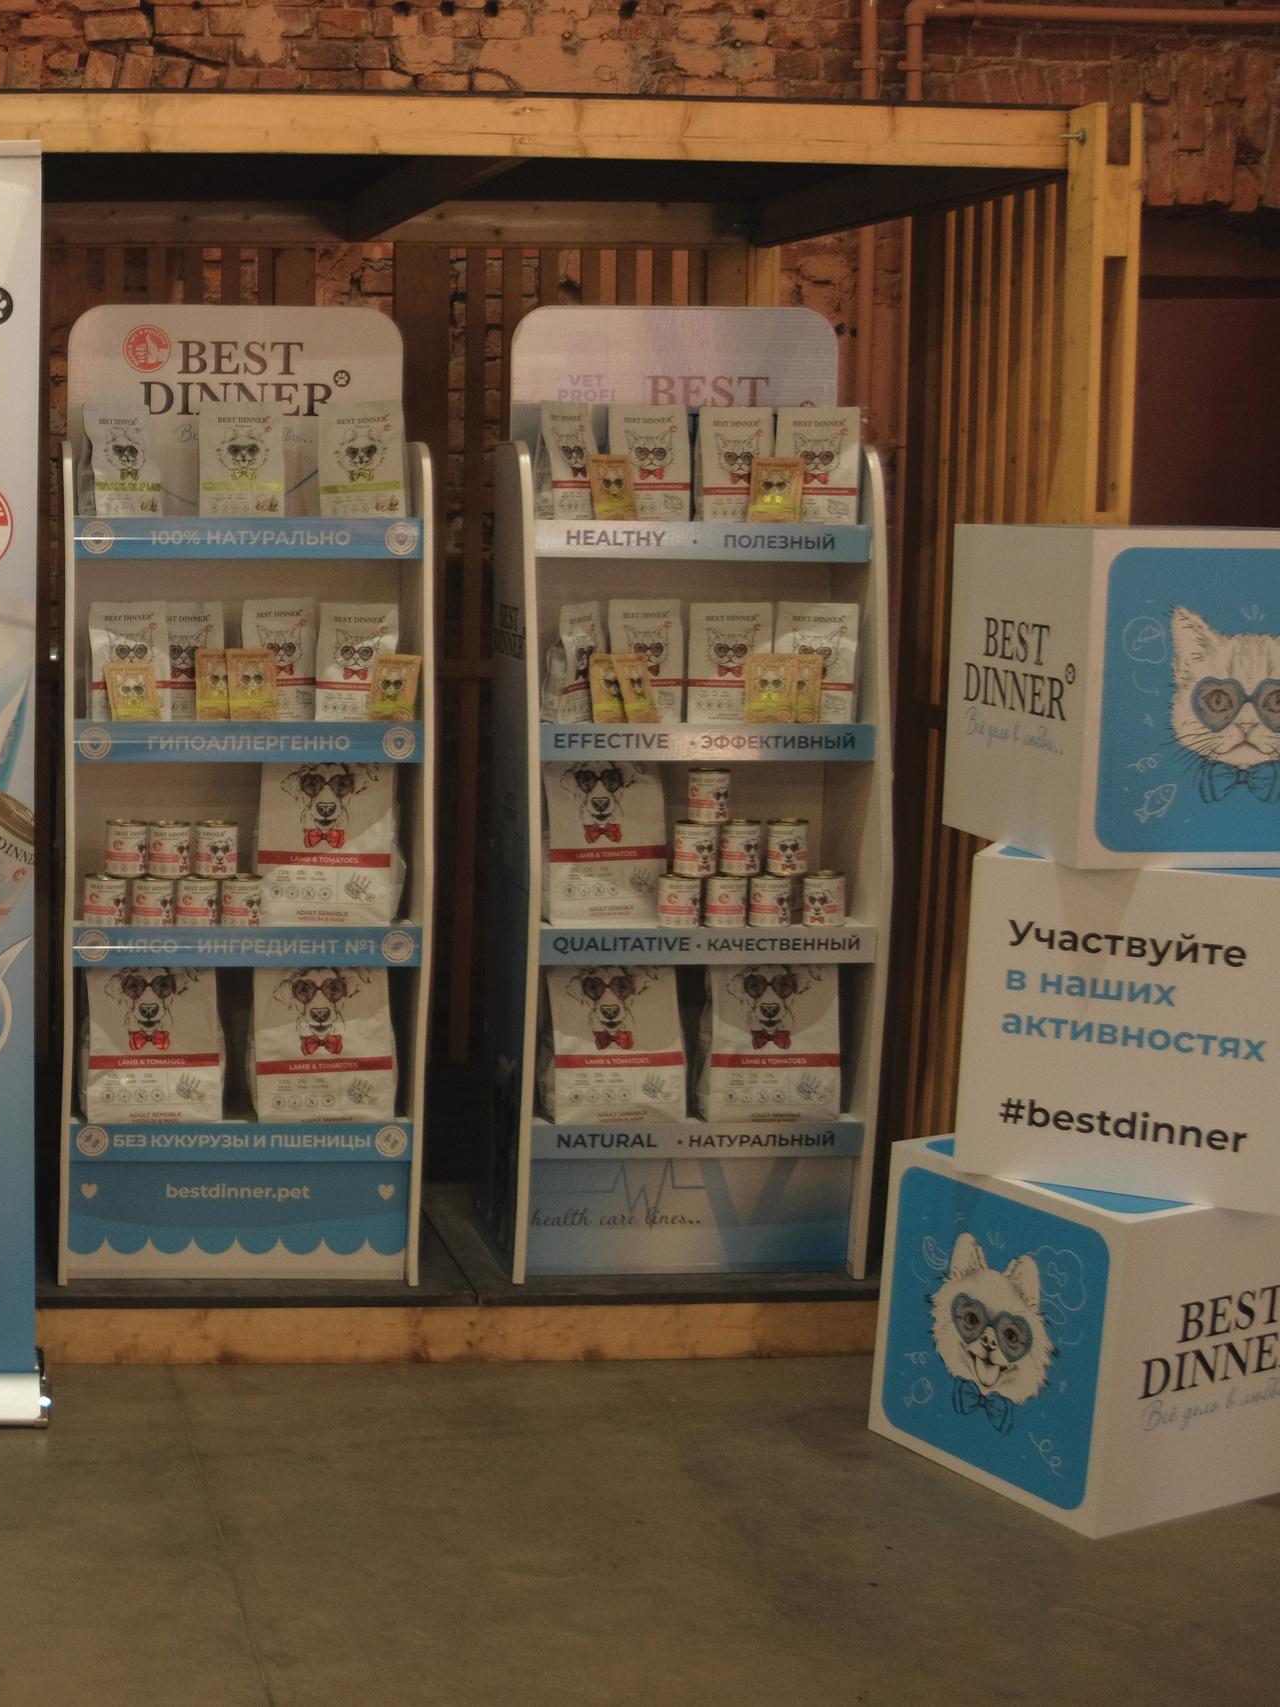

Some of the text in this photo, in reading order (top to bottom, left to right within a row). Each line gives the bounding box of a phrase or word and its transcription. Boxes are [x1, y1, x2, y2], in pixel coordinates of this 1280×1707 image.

[177, 341, 304, 376] BEST
[569, 375, 605, 387] VET
[557, 389, 615, 402] PROFI
[647, 375, 769, 407] BEST
[217, 416, 268, 424] BEST DINNER
[357, 416, 387, 424] DINNER
[149, 530, 351, 546] 100% НАТУРАЛЬНО
[565, 530, 666, 547] HEALTHY
[724, 532, 836, 550] ПОЛЕЗНЫЙ
[124, 613, 152, 621] DINNER
[274, 610, 302, 618] DINNER
[354, 616, 385, 624] DINNER
[983, 617, 1050, 666] BEST
[963, 662, 1066, 721] DINNER
[147, 734, 351, 751] ГИПОАЛЛЕРГЕННО
[554, 732, 669, 749] EFFECTIVE
[700, 731, 856, 751] ЭФФЕКТИВНЫЙ
[117, 938, 375, 956] МЯСО ИНГРЕДИЕНТ №1
[552, 936, 691, 953] QUALITATIVE
[707, 934, 861, 952] КАЧЕСТВЕННЫЙ
[1008, 918, 1246, 968] Участвуйте
[1006, 969, 1176, 1006] в наших
[1001, 1012, 1266, 1062] активностях
[998, 1098, 1248, 1153] #bestdinner
[113, 1134, 371, 1151] БЕЗ КУКУРУЗЫ И ПШЕНИЦЫ
[556, 1132, 657, 1148] NATURAL
[689, 1130, 836, 1148] НАТУРАЛЬНЫЙ
[166, 1183, 310, 1202] bestdinner.pet
[531, 1208, 592, 1227] health
[599, 1211, 638, 1226] care
[1176, 1284, 1280, 1344] BEST
[1138, 1332, 1280, 1400] DINNE
